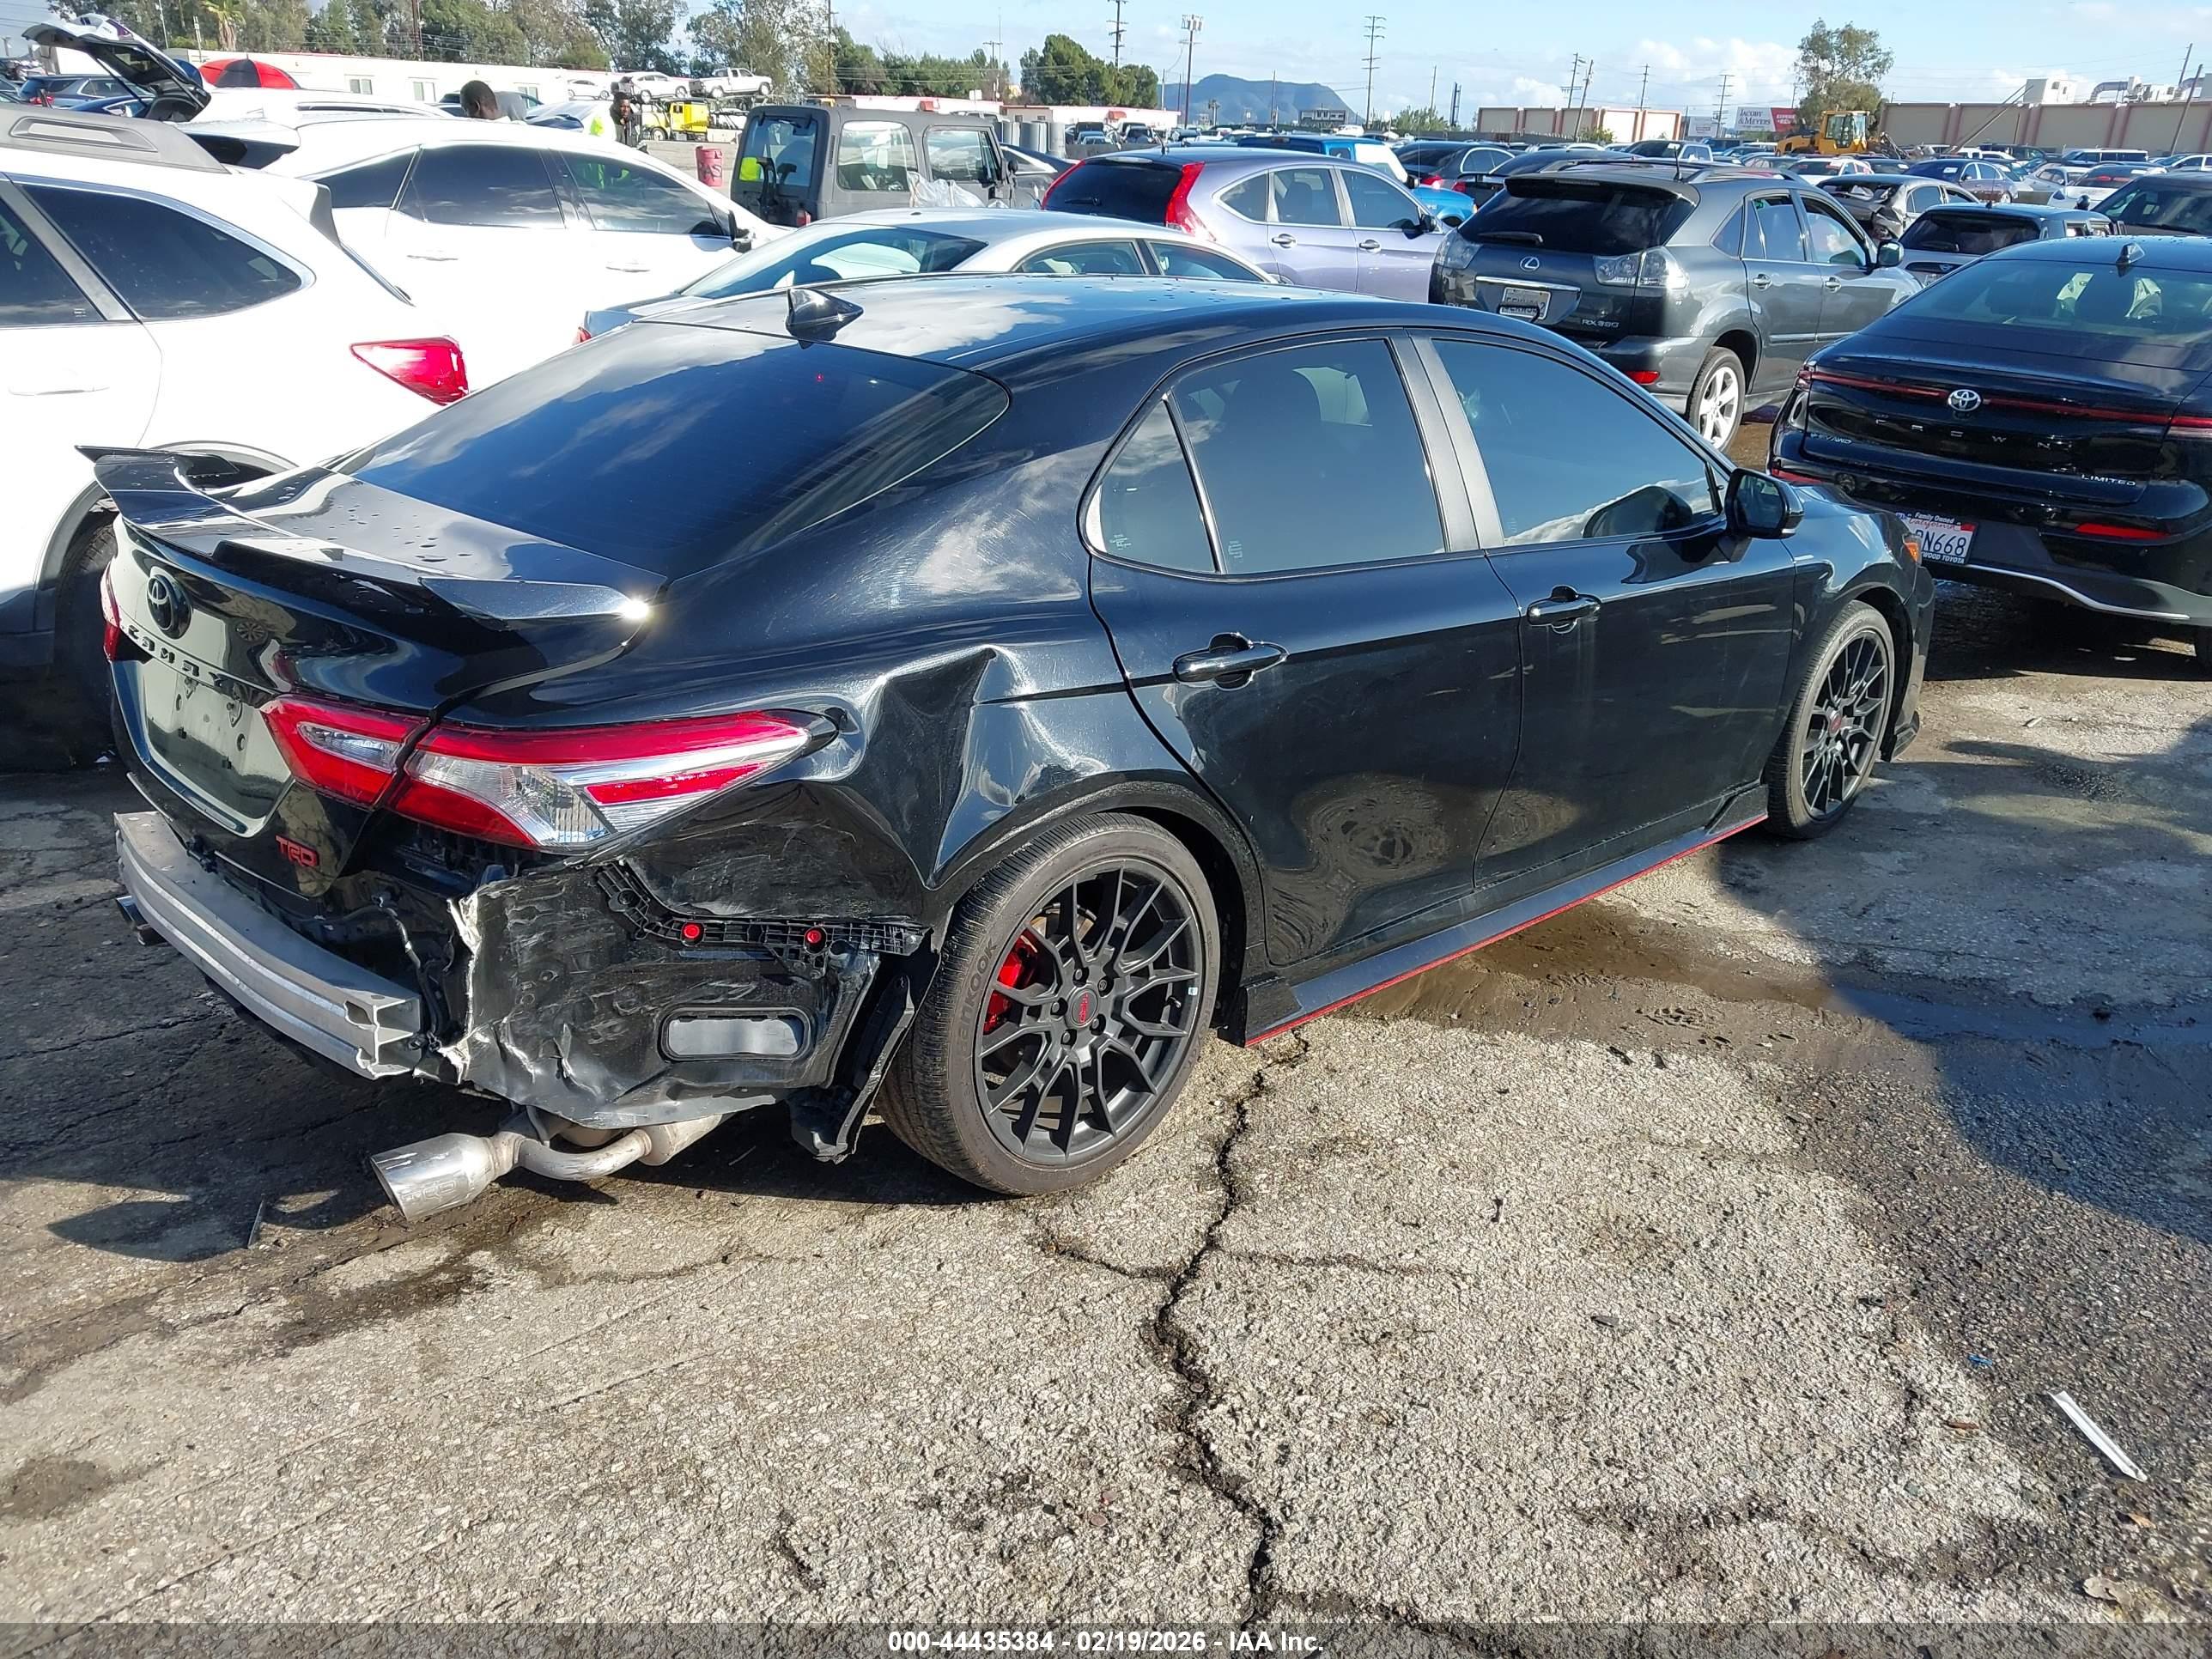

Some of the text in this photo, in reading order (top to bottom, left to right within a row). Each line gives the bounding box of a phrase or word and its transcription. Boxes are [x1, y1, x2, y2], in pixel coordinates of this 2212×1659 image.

[2081, 474, 2136, 486] LIMITED
[1915, 512, 1955, 524] Family Owned
[1942, 555, 1965, 563] TOYOTA
[275, 834, 319, 867] TRD
